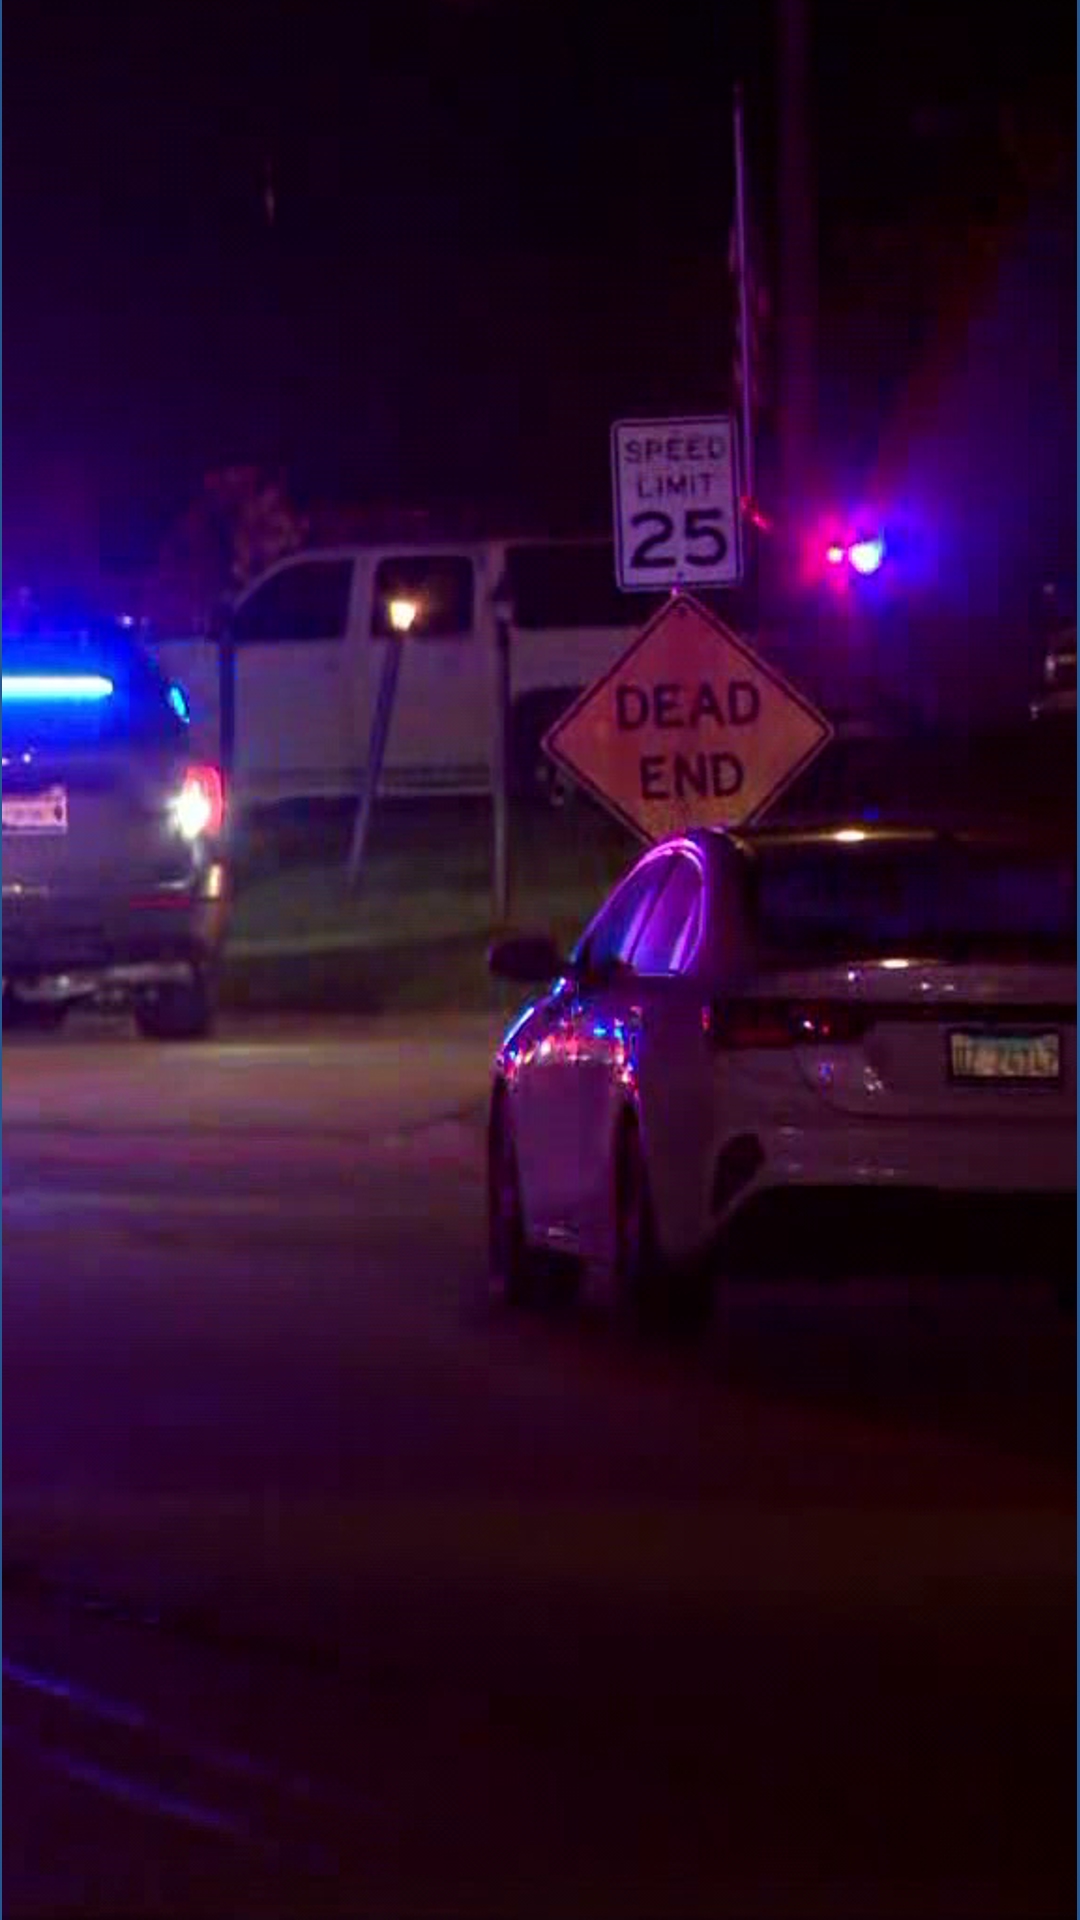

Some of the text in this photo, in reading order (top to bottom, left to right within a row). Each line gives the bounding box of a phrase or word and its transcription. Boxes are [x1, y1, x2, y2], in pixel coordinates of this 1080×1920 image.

[624, 437, 727, 463] SPEED
[638, 473, 711, 498] LIMIT
[630, 508, 728, 568] 25
[616, 681, 760, 730] DEAD
[641, 752, 744, 800] END
